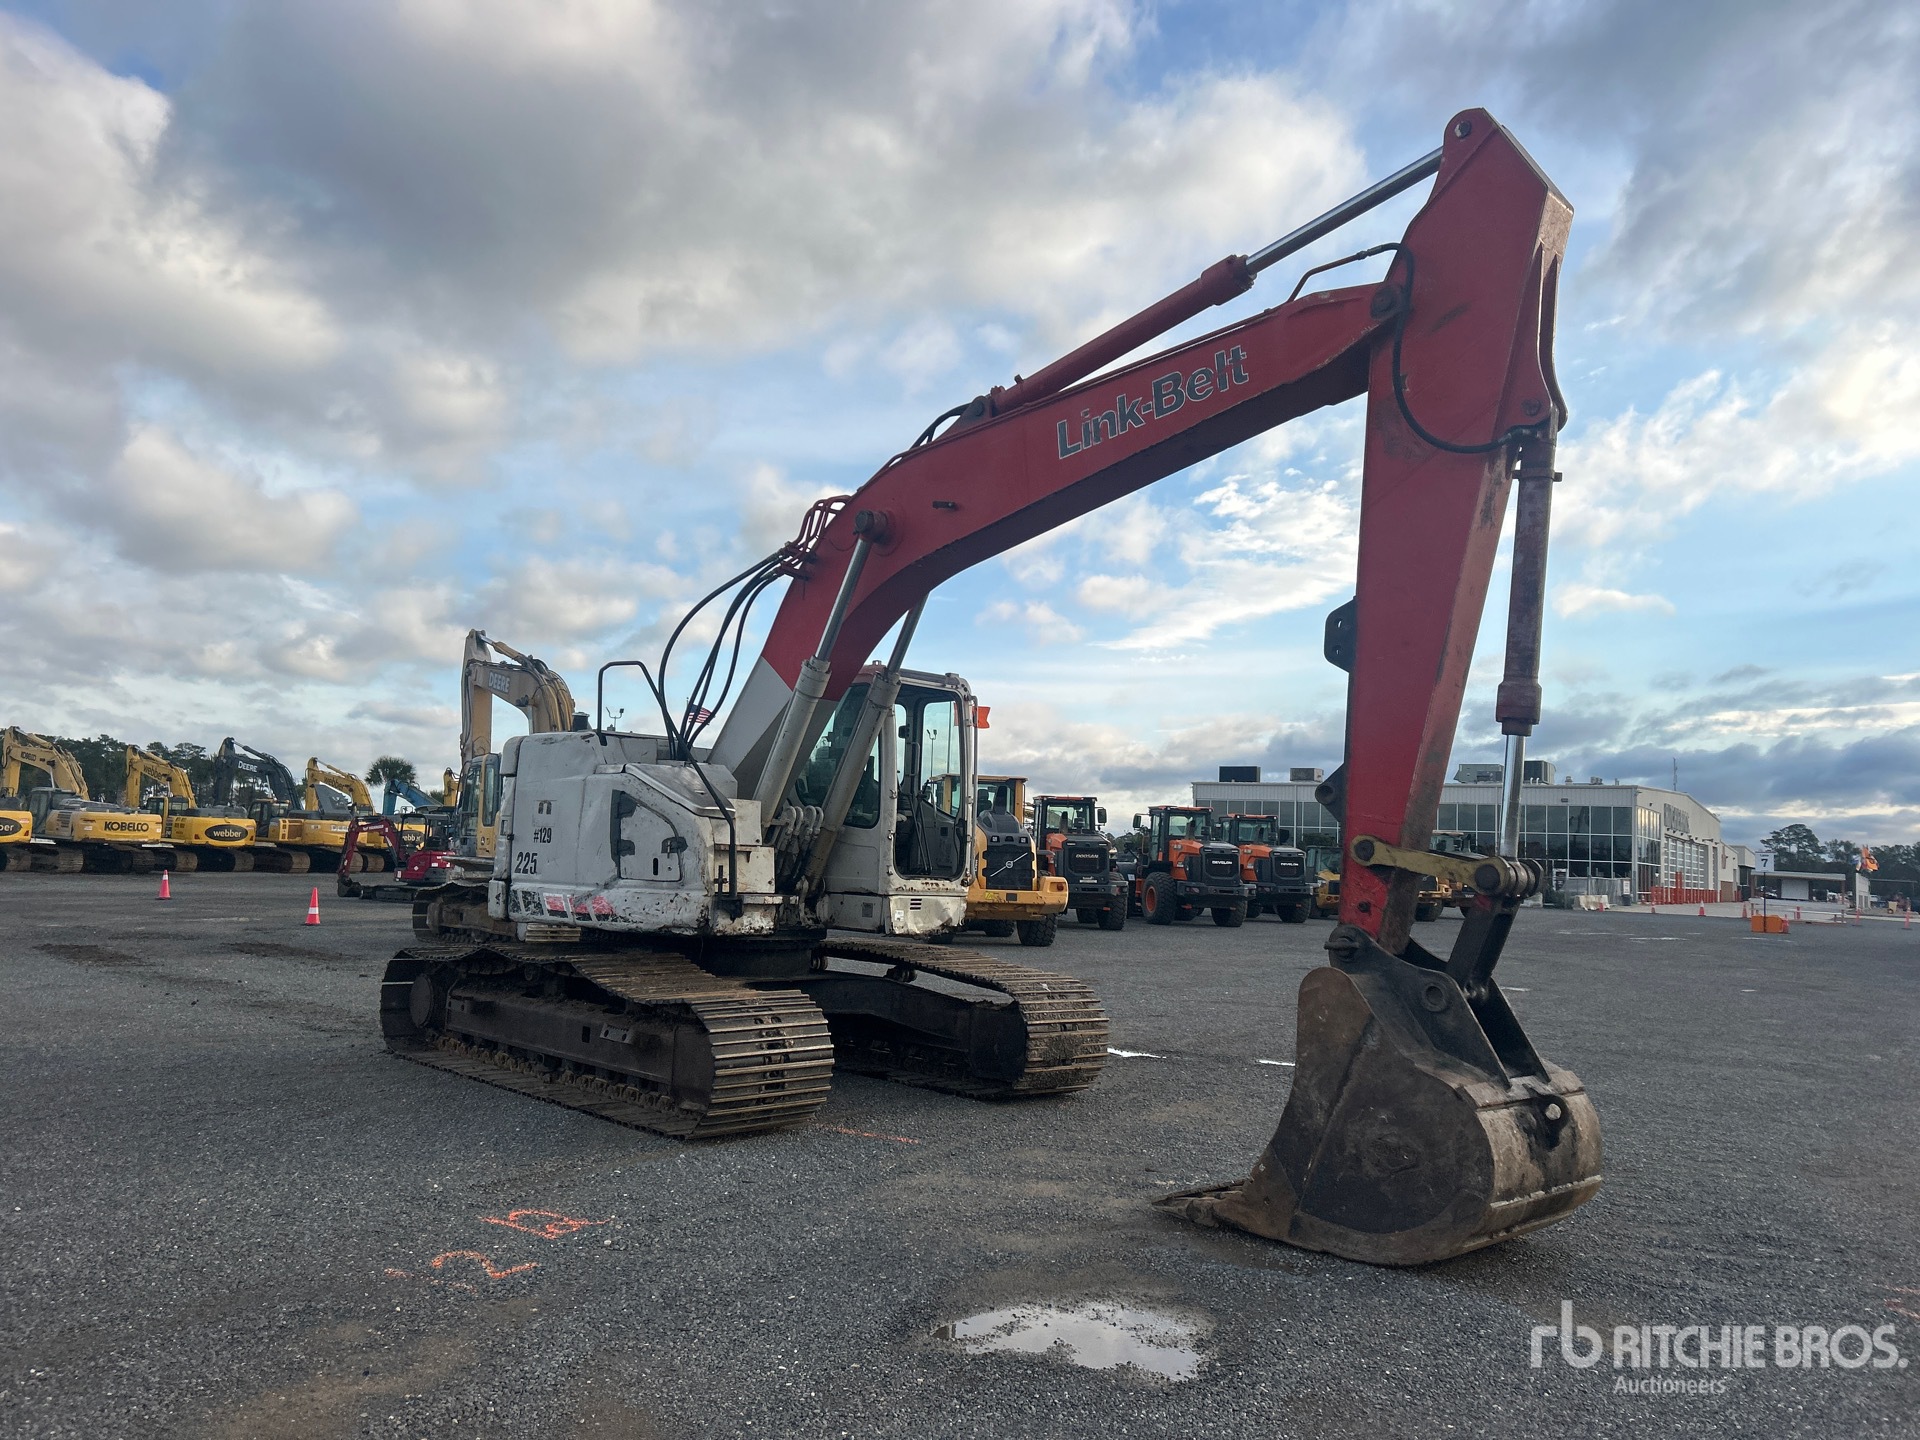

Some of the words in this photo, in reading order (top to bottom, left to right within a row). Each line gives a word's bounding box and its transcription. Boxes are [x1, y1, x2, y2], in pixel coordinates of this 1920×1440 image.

[1057, 345, 1249, 459] Link-Belt
[488, 671, 510, 693] DEERE
[143, 764, 163, 780] webber
[238, 760, 258, 773] DEERE
[104, 821, 149, 833] KOBELCO
[213, 829, 242, 839] webber
[533, 827, 552, 844] #129
[514, 851, 538, 875] 225
[1760, 858, 1769, 868] 7
